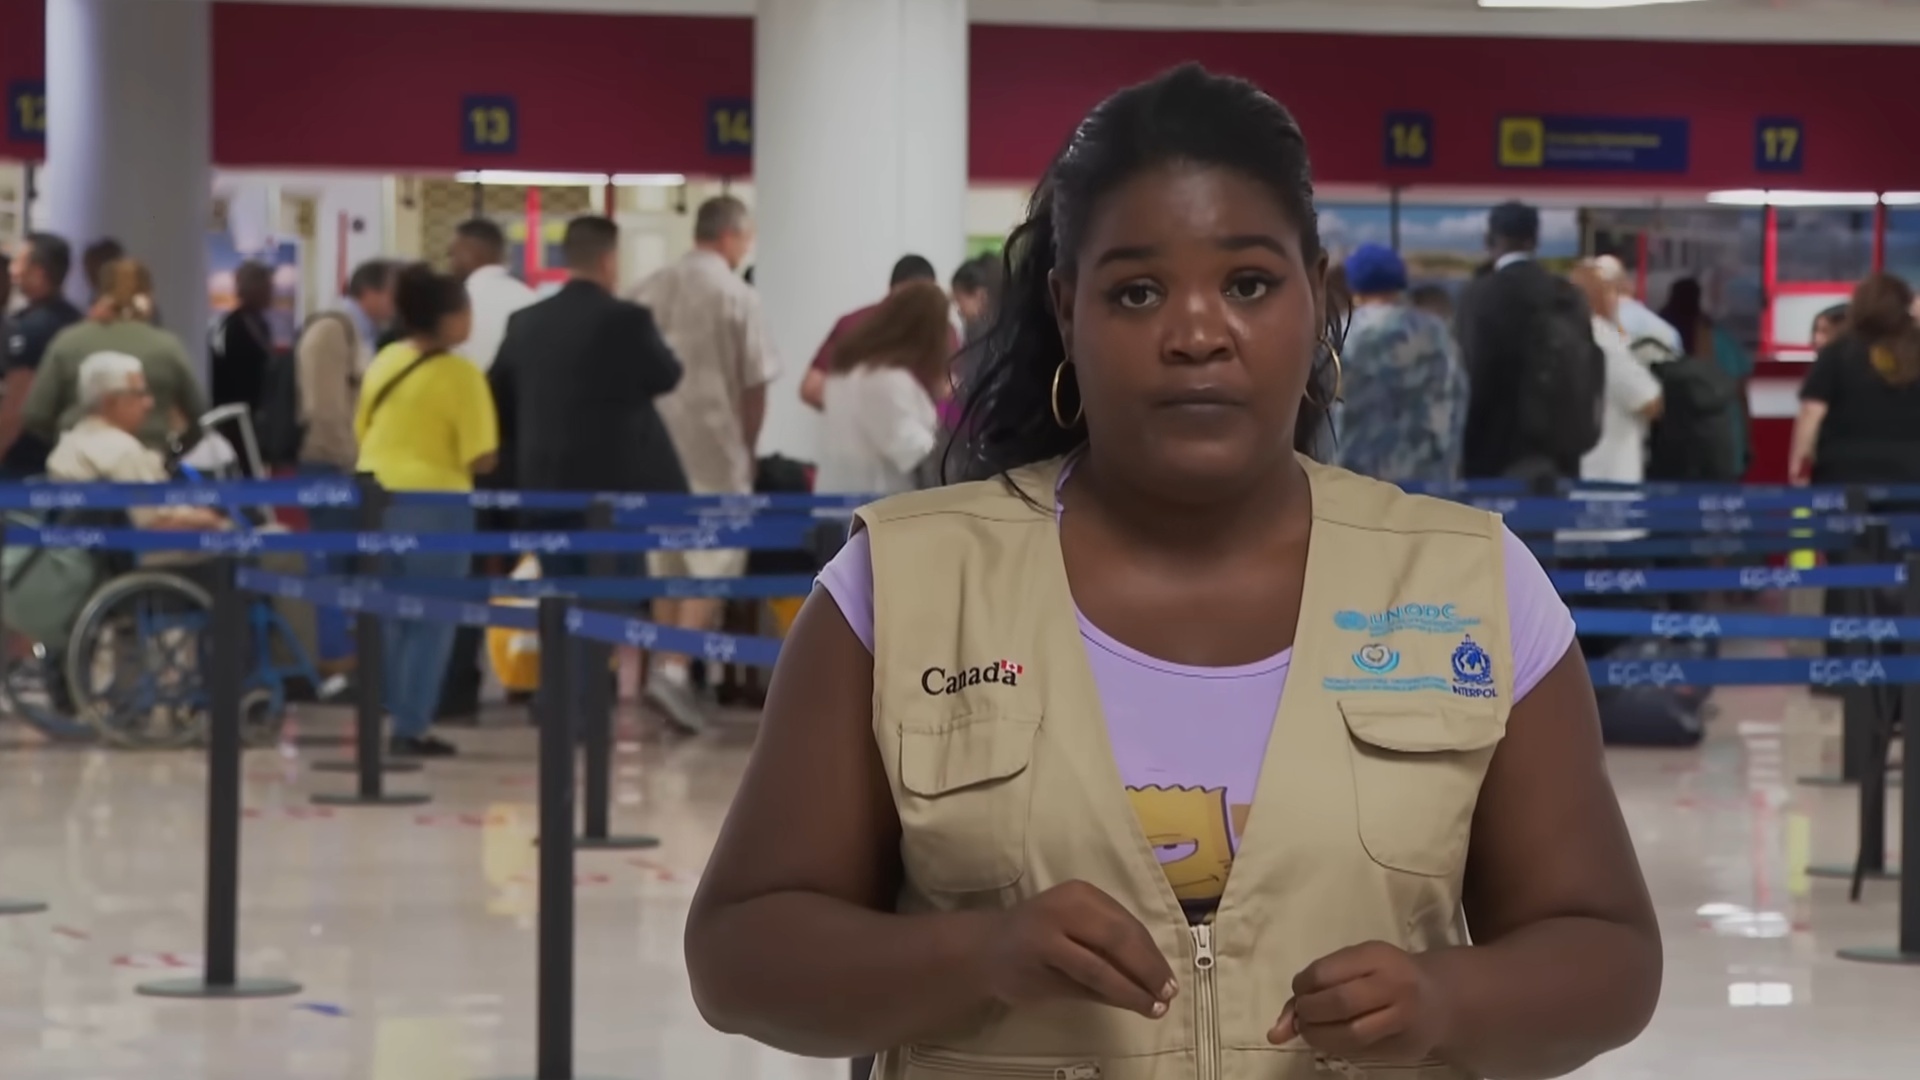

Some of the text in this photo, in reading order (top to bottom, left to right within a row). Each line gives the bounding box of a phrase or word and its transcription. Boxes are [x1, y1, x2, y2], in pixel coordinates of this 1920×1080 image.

[470, 106, 509, 144] 13
[715, 109, 752, 145] 14
[1390, 124, 1426, 158] 16
[1762, 127, 1799, 161] 17
[921, 662, 1017, 695] Canada
